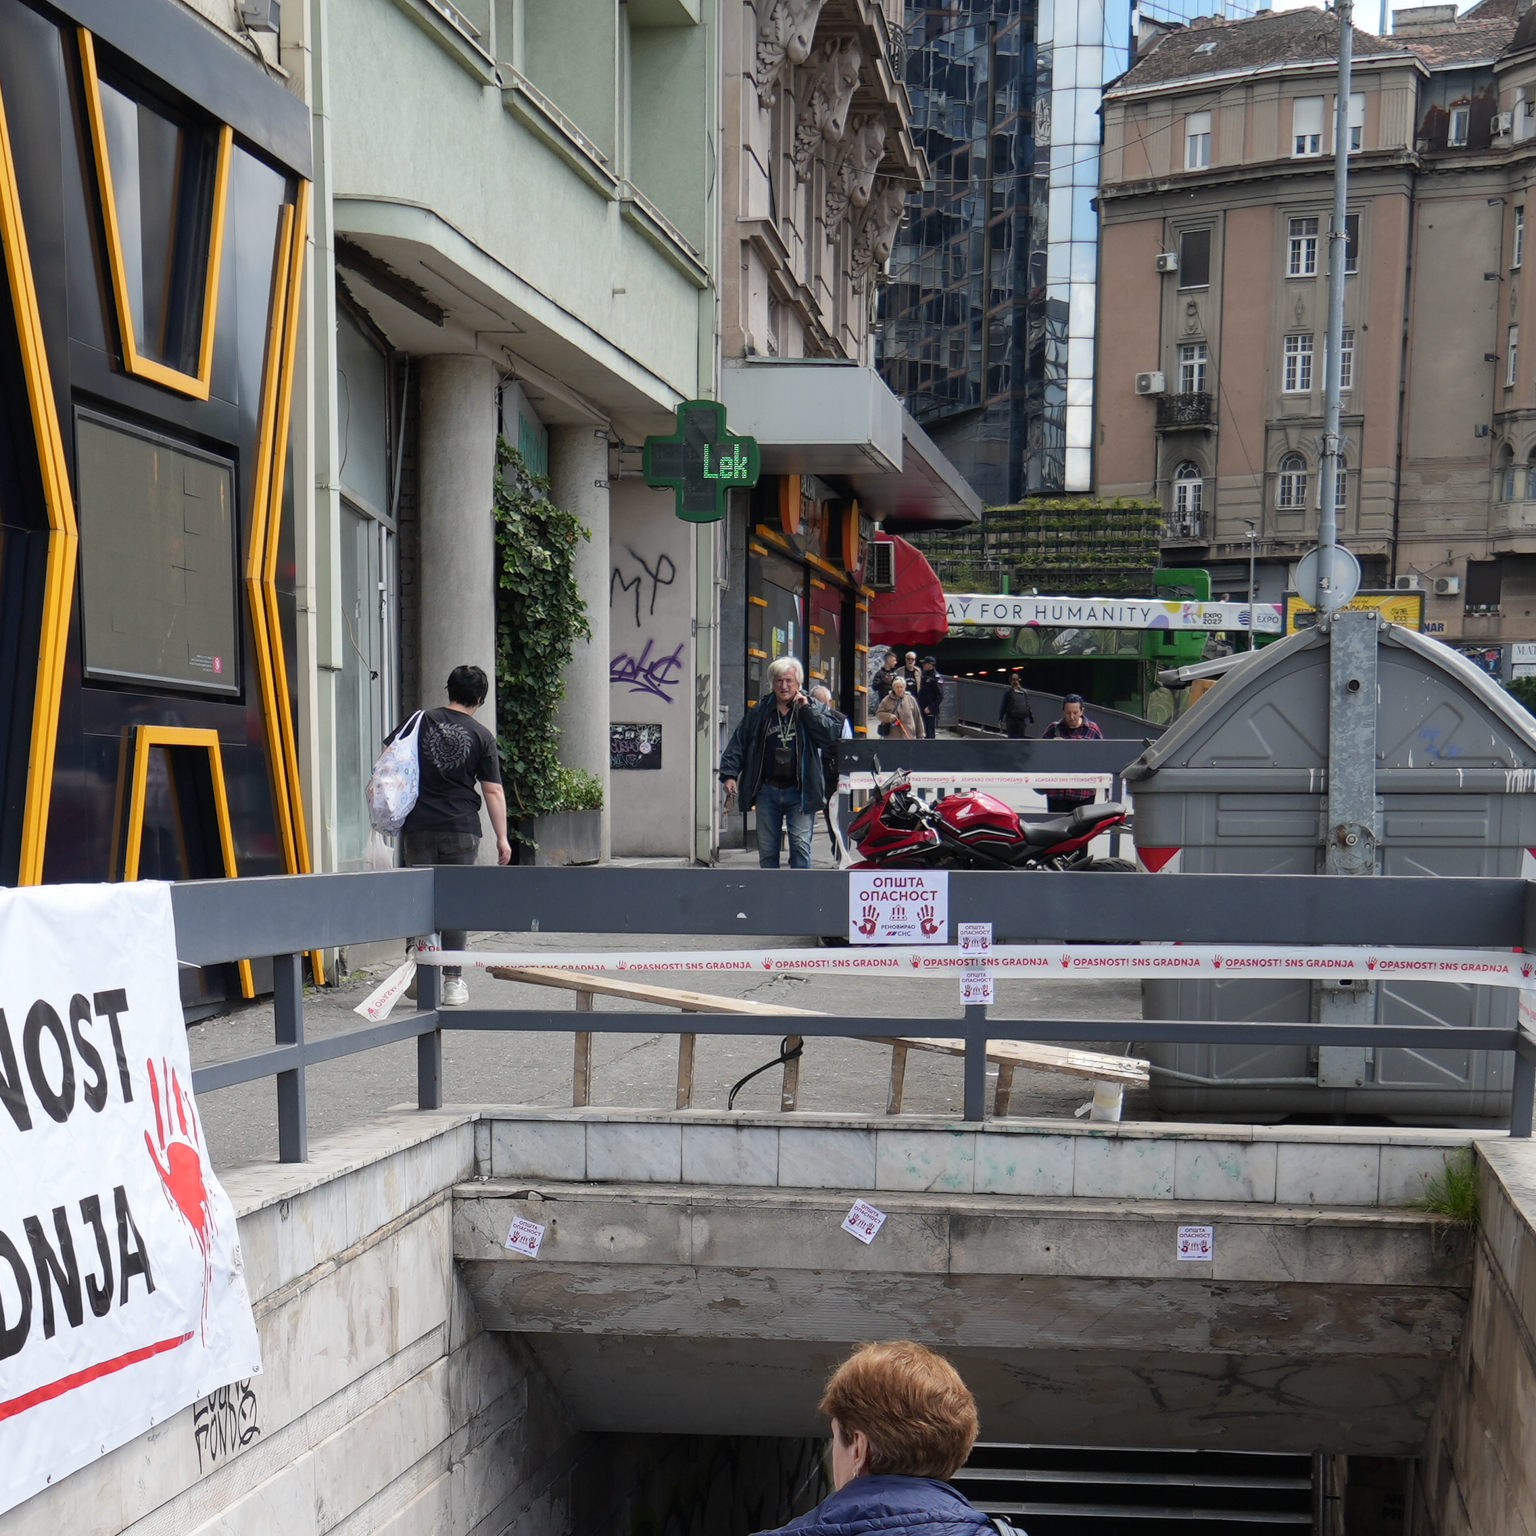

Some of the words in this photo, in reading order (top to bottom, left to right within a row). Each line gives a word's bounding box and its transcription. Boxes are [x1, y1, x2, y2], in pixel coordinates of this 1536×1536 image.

[703, 444, 747, 479] Lek
[980, 604, 1023, 619] FOR
[1035, 604, 1152, 622] HUMANITY
[1257, 616, 1279, 624] EXPO
[873, 877, 924, 888] ОПШТА
[860, 890, 938, 901] ОПАСНОСТ
[705, 961, 752, 969] GRADNJA
[775, 960, 830, 969] OPASNOST!
[852, 959, 899, 967] GRADNJA
[923, 958, 979, 966] OPASNOST!
[980, 958, 999, 966] SNS
[1002, 957, 1049, 966] GRADNJA
[1073, 958, 1129, 967] OPASNOST!
[1132, 958, 1151, 966] SNS
[1152, 958, 1200, 966] GRADNJA
[1225, 958, 1282, 967] OPASNOST!
[1284, 959, 1304, 967] SNS
[1306, 959, 1354, 968] GRADNJA
[1379, 961, 1436, 969] OPASNOST!
[1439, 962, 1458, 970] SNS
[1460, 963, 1509, 973] GRADNJA
